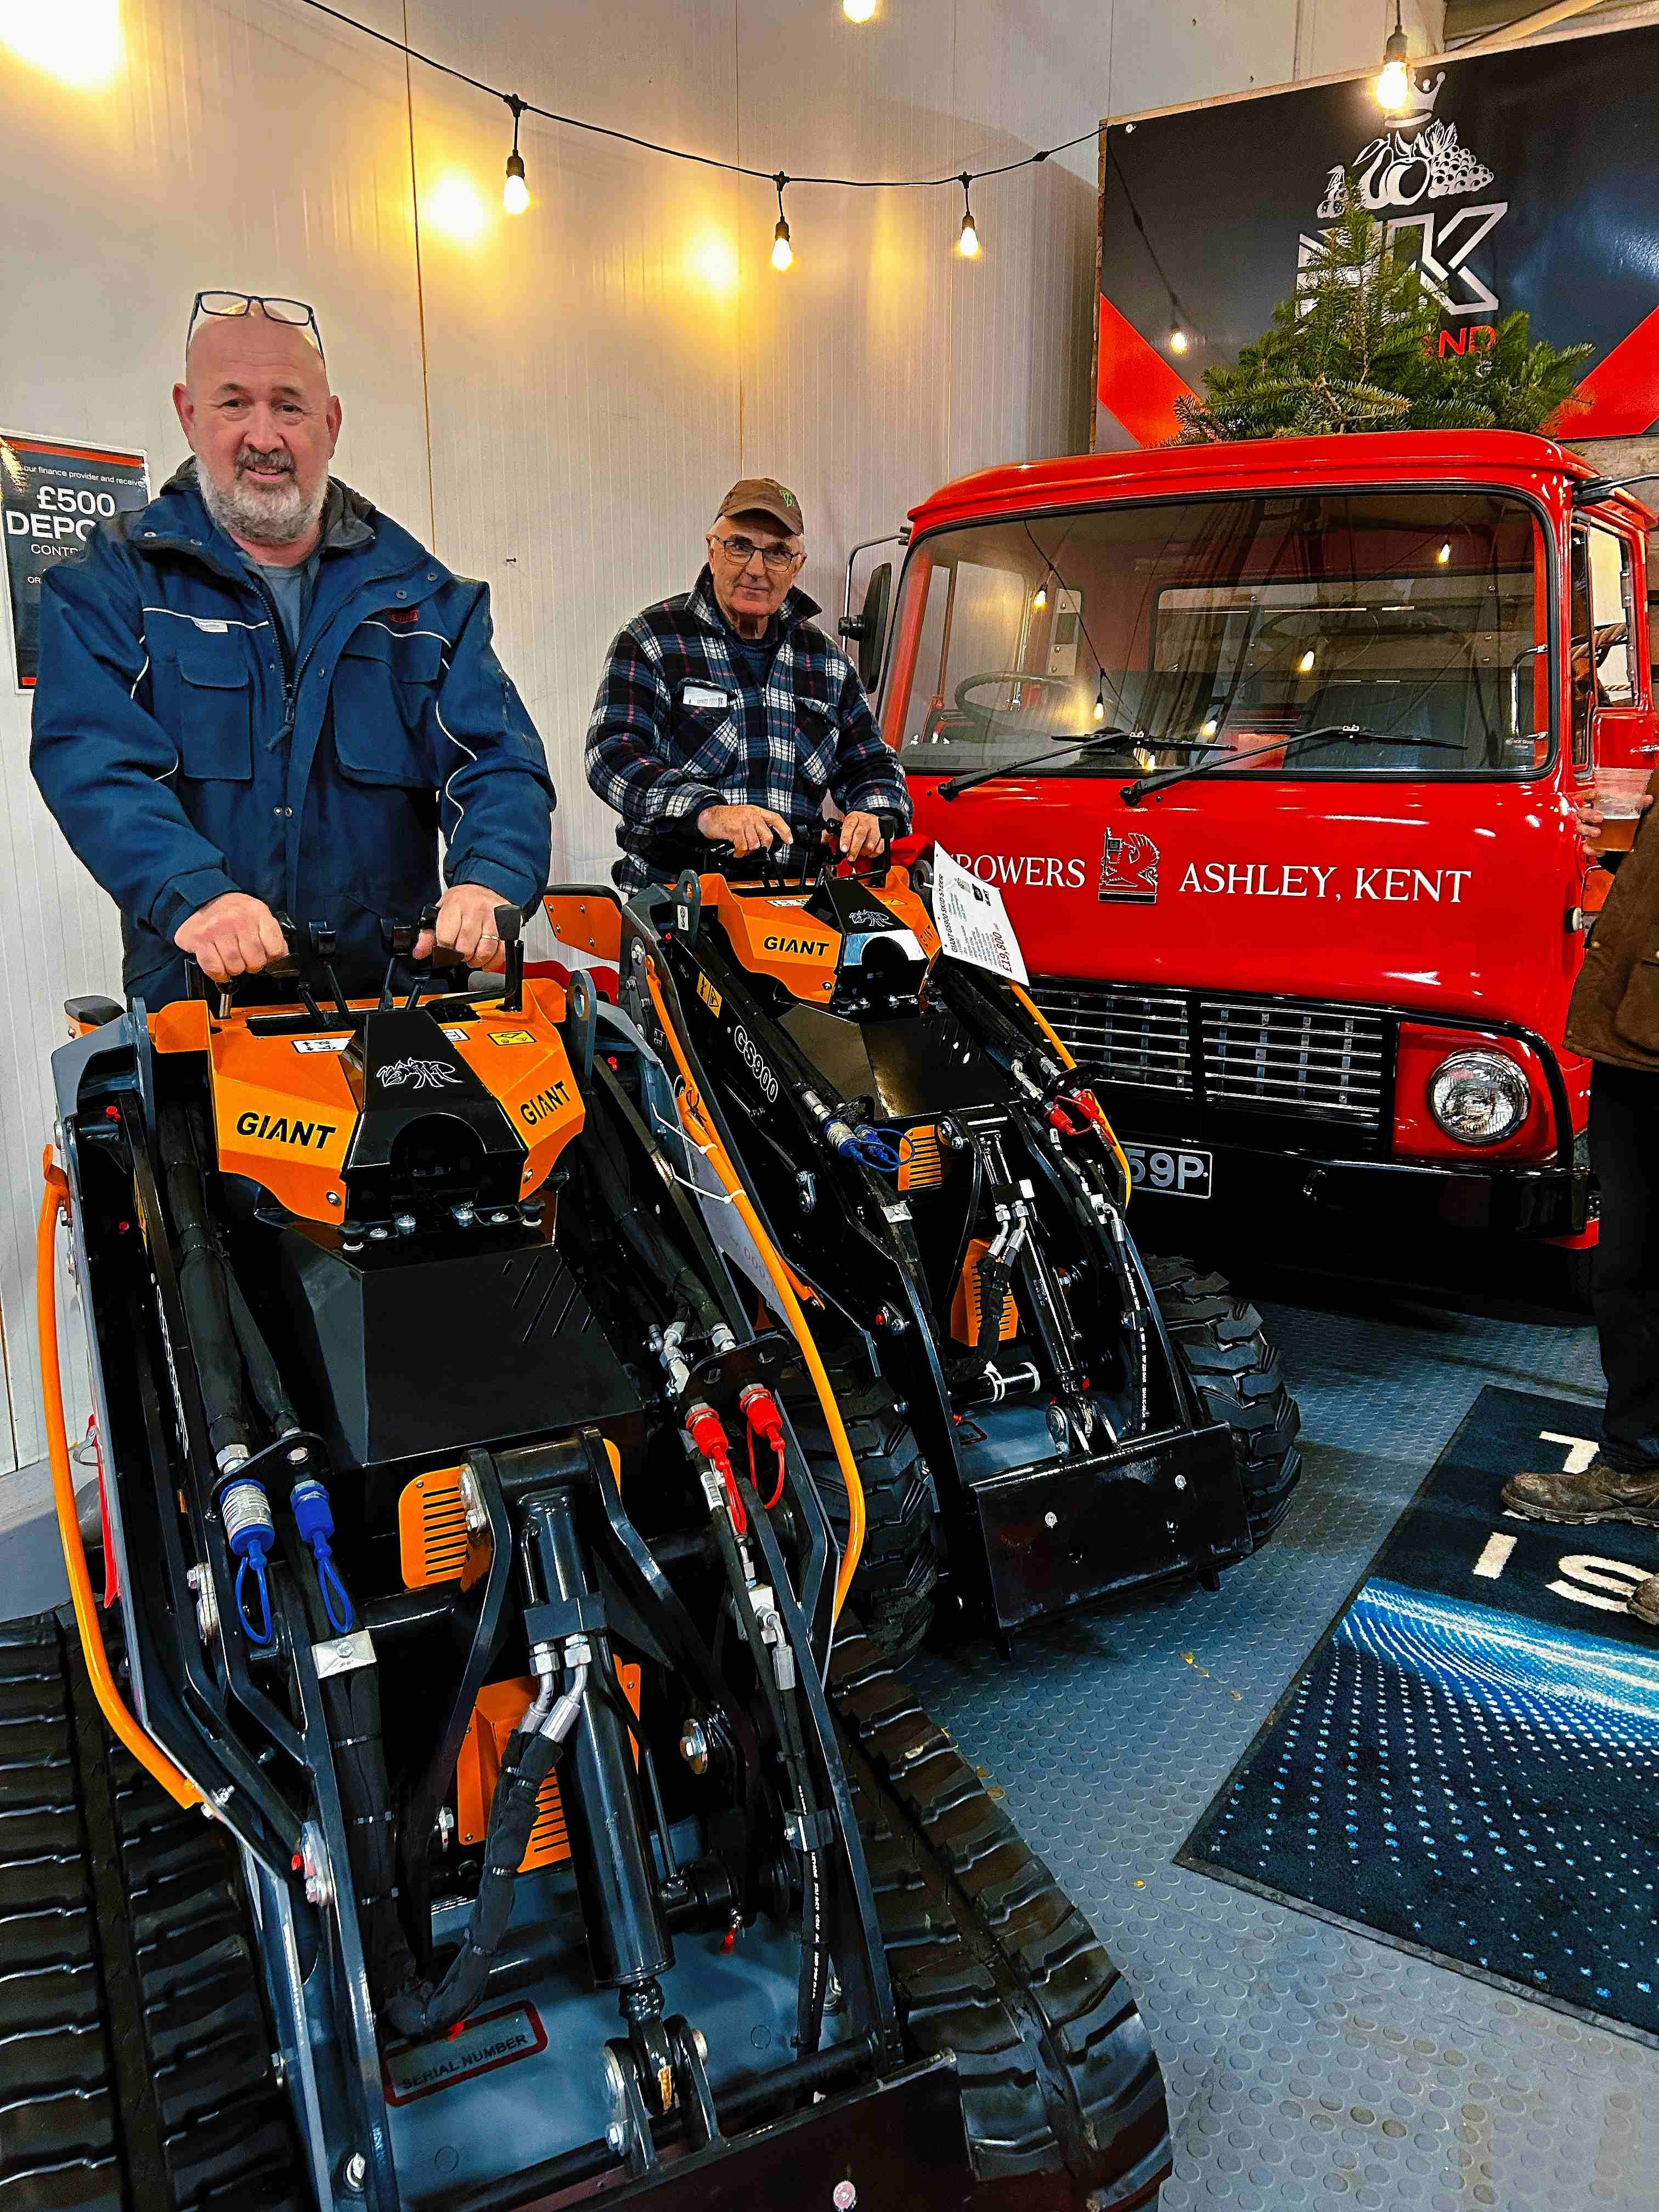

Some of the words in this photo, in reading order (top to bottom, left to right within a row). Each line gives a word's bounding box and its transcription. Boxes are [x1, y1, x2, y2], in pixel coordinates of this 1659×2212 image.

[38, 466, 67, 476] finance
[69, 471, 99, 481] provider
[36, 486, 115, 517] £500
[1178, 862, 1341, 901] ASHLEY,
[1355, 867, 1472, 902] KENT
[764, 936, 830, 956] GIANT
[947, 933, 958, 952] GIANT
[992, 932, 1013, 973] £19,800
[734, 1025, 778, 1102] GS900
[520, 1080, 571, 1126] GIANT
[236, 1112, 337, 1149] GIANT
[402, 2061, 460, 2089] SERIAL
[461, 2034, 528, 2067] NUMBER
